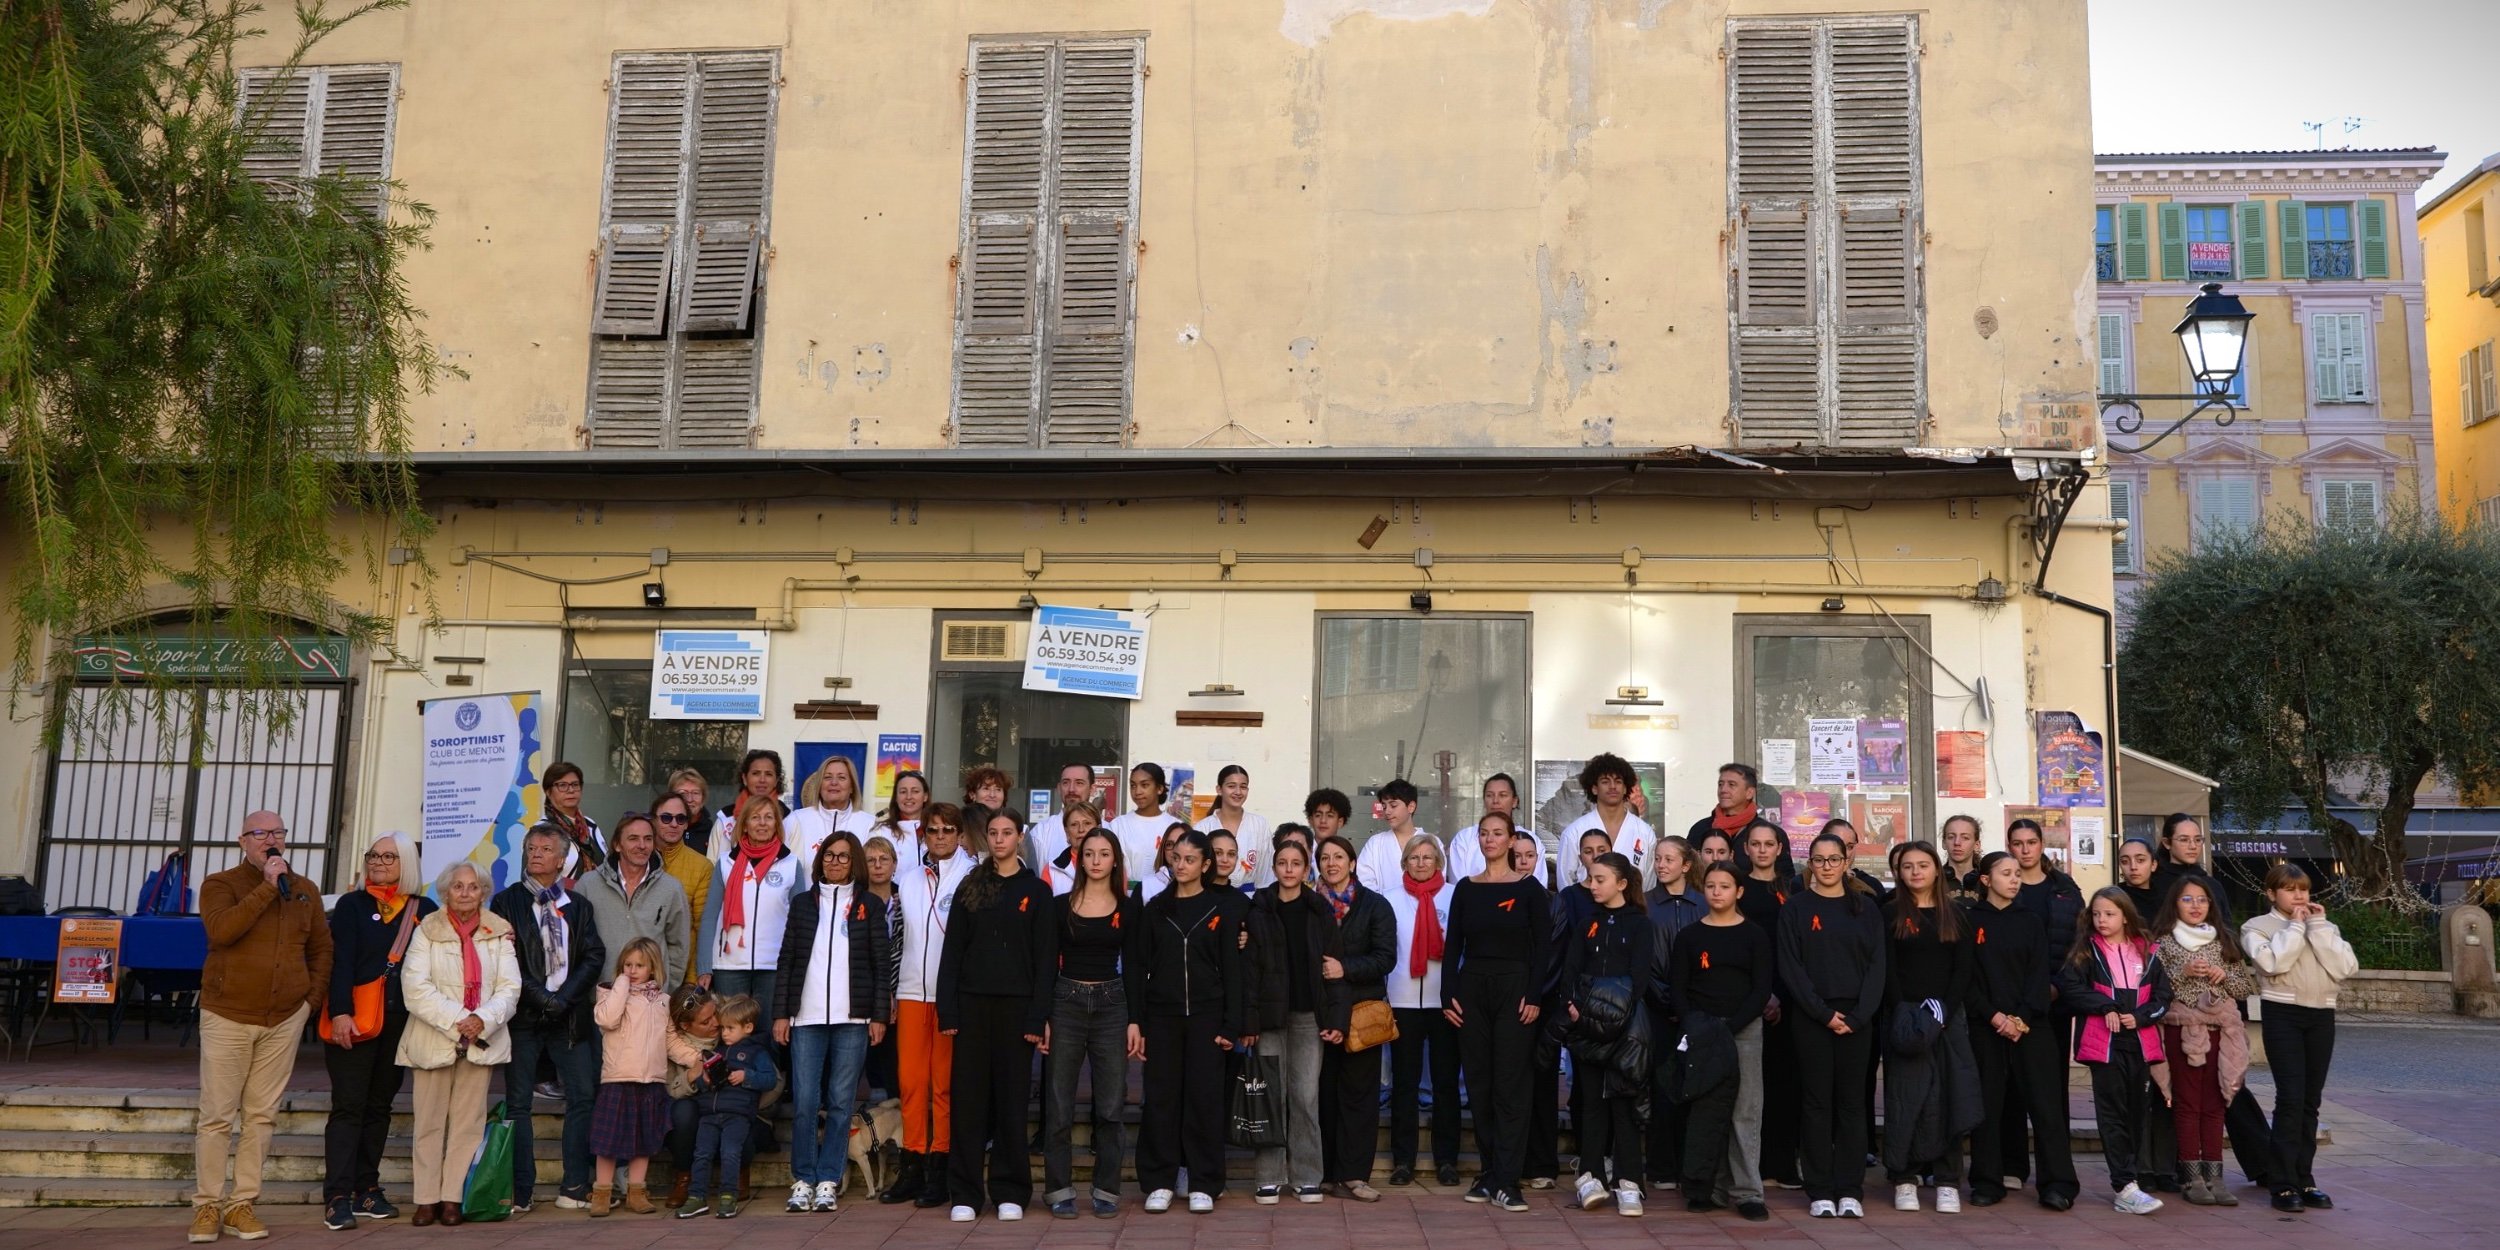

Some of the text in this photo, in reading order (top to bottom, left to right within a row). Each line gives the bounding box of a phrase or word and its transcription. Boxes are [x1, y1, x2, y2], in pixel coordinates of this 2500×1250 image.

[2199, 243, 2229, 252] VENDRE
[2042, 405, 2078, 418] PLACE
[2051, 421, 2068, 435] DU
[1039, 625, 1140, 651] À VENDRE
[662, 652, 761, 670] À VENDRE
[1062, 676, 1087, 684] AGENCE
[430, 735, 505, 748] SOROPTIMIST
[882, 742, 918, 752] CACTUS
[430, 747, 505, 758] CLUB DE MENTON
[2235, 842, 2279, 853] GASCONS
[68, 956, 103, 968] STOP
